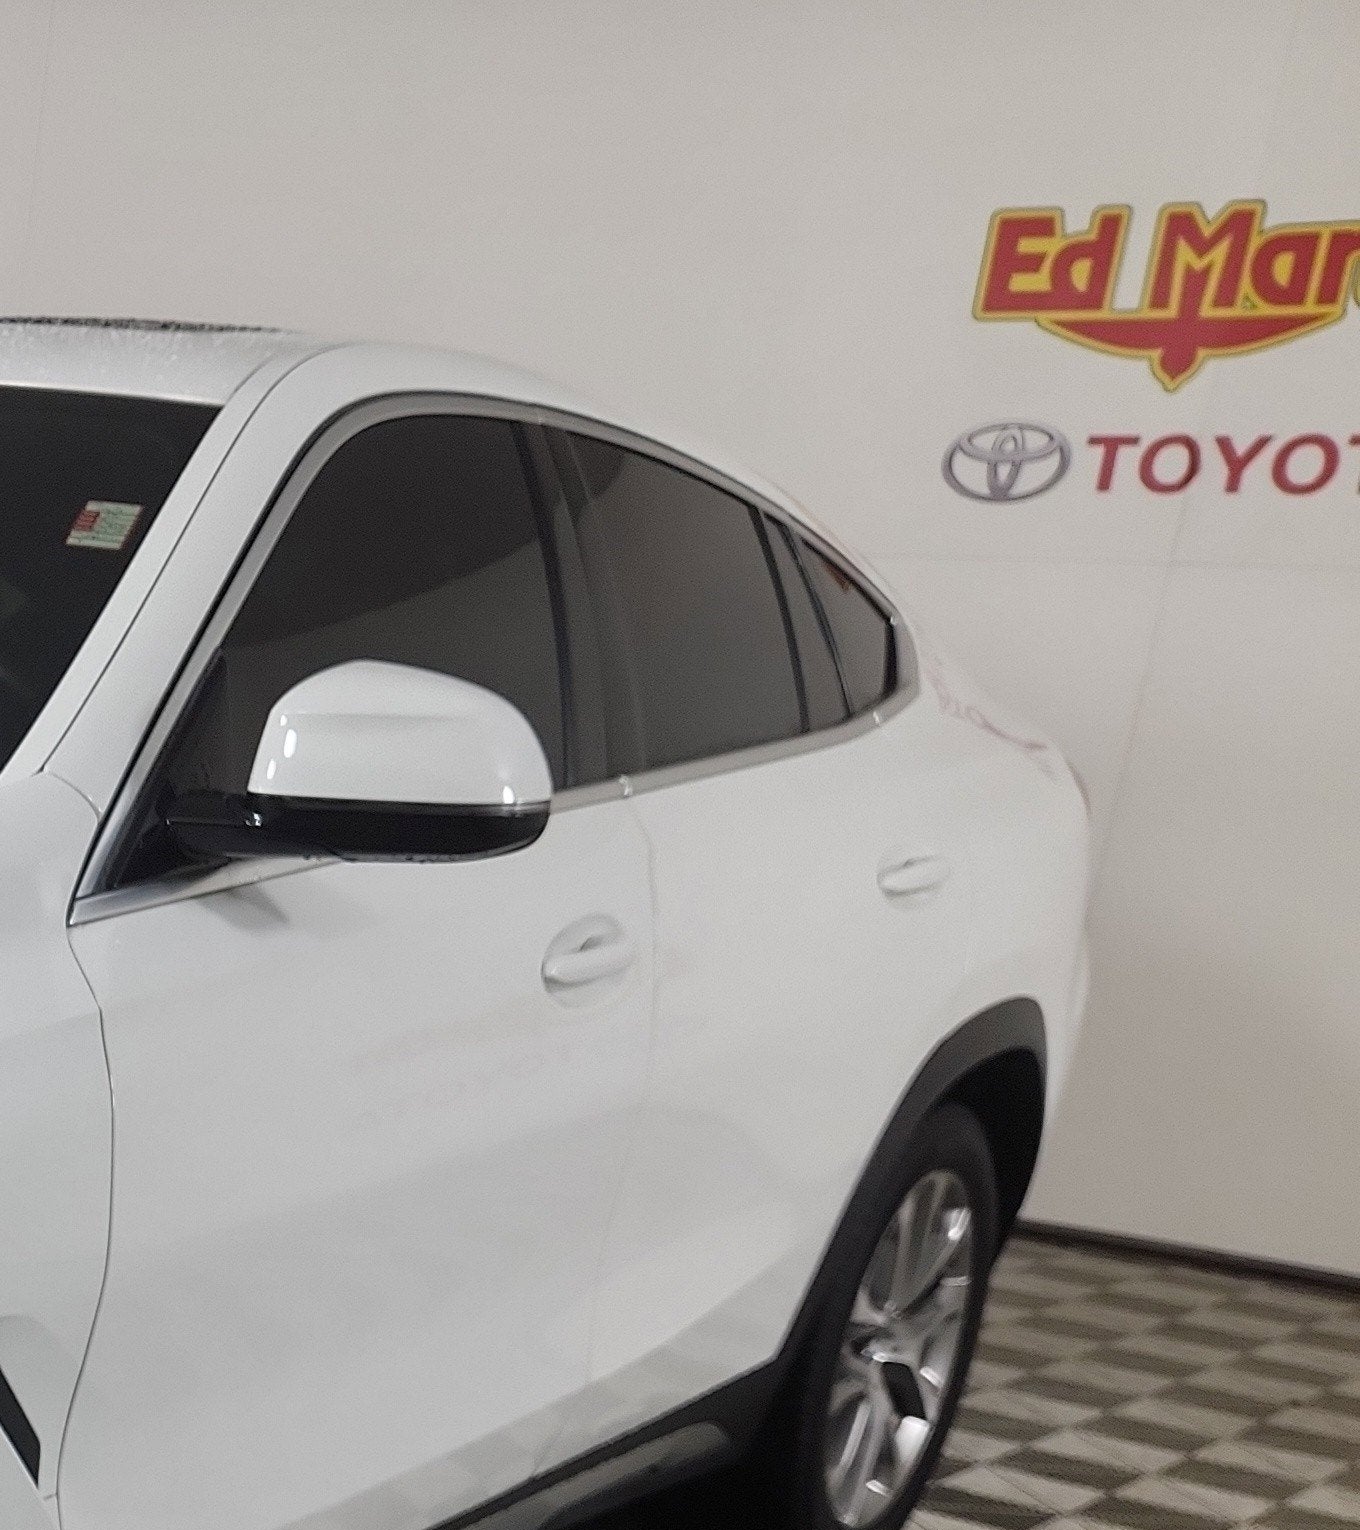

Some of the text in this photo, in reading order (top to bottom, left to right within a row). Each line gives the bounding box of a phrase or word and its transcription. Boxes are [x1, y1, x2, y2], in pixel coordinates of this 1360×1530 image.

[979, 204, 1360, 316] Ed Mar
[1087, 434, 1360, 495] TOYO
